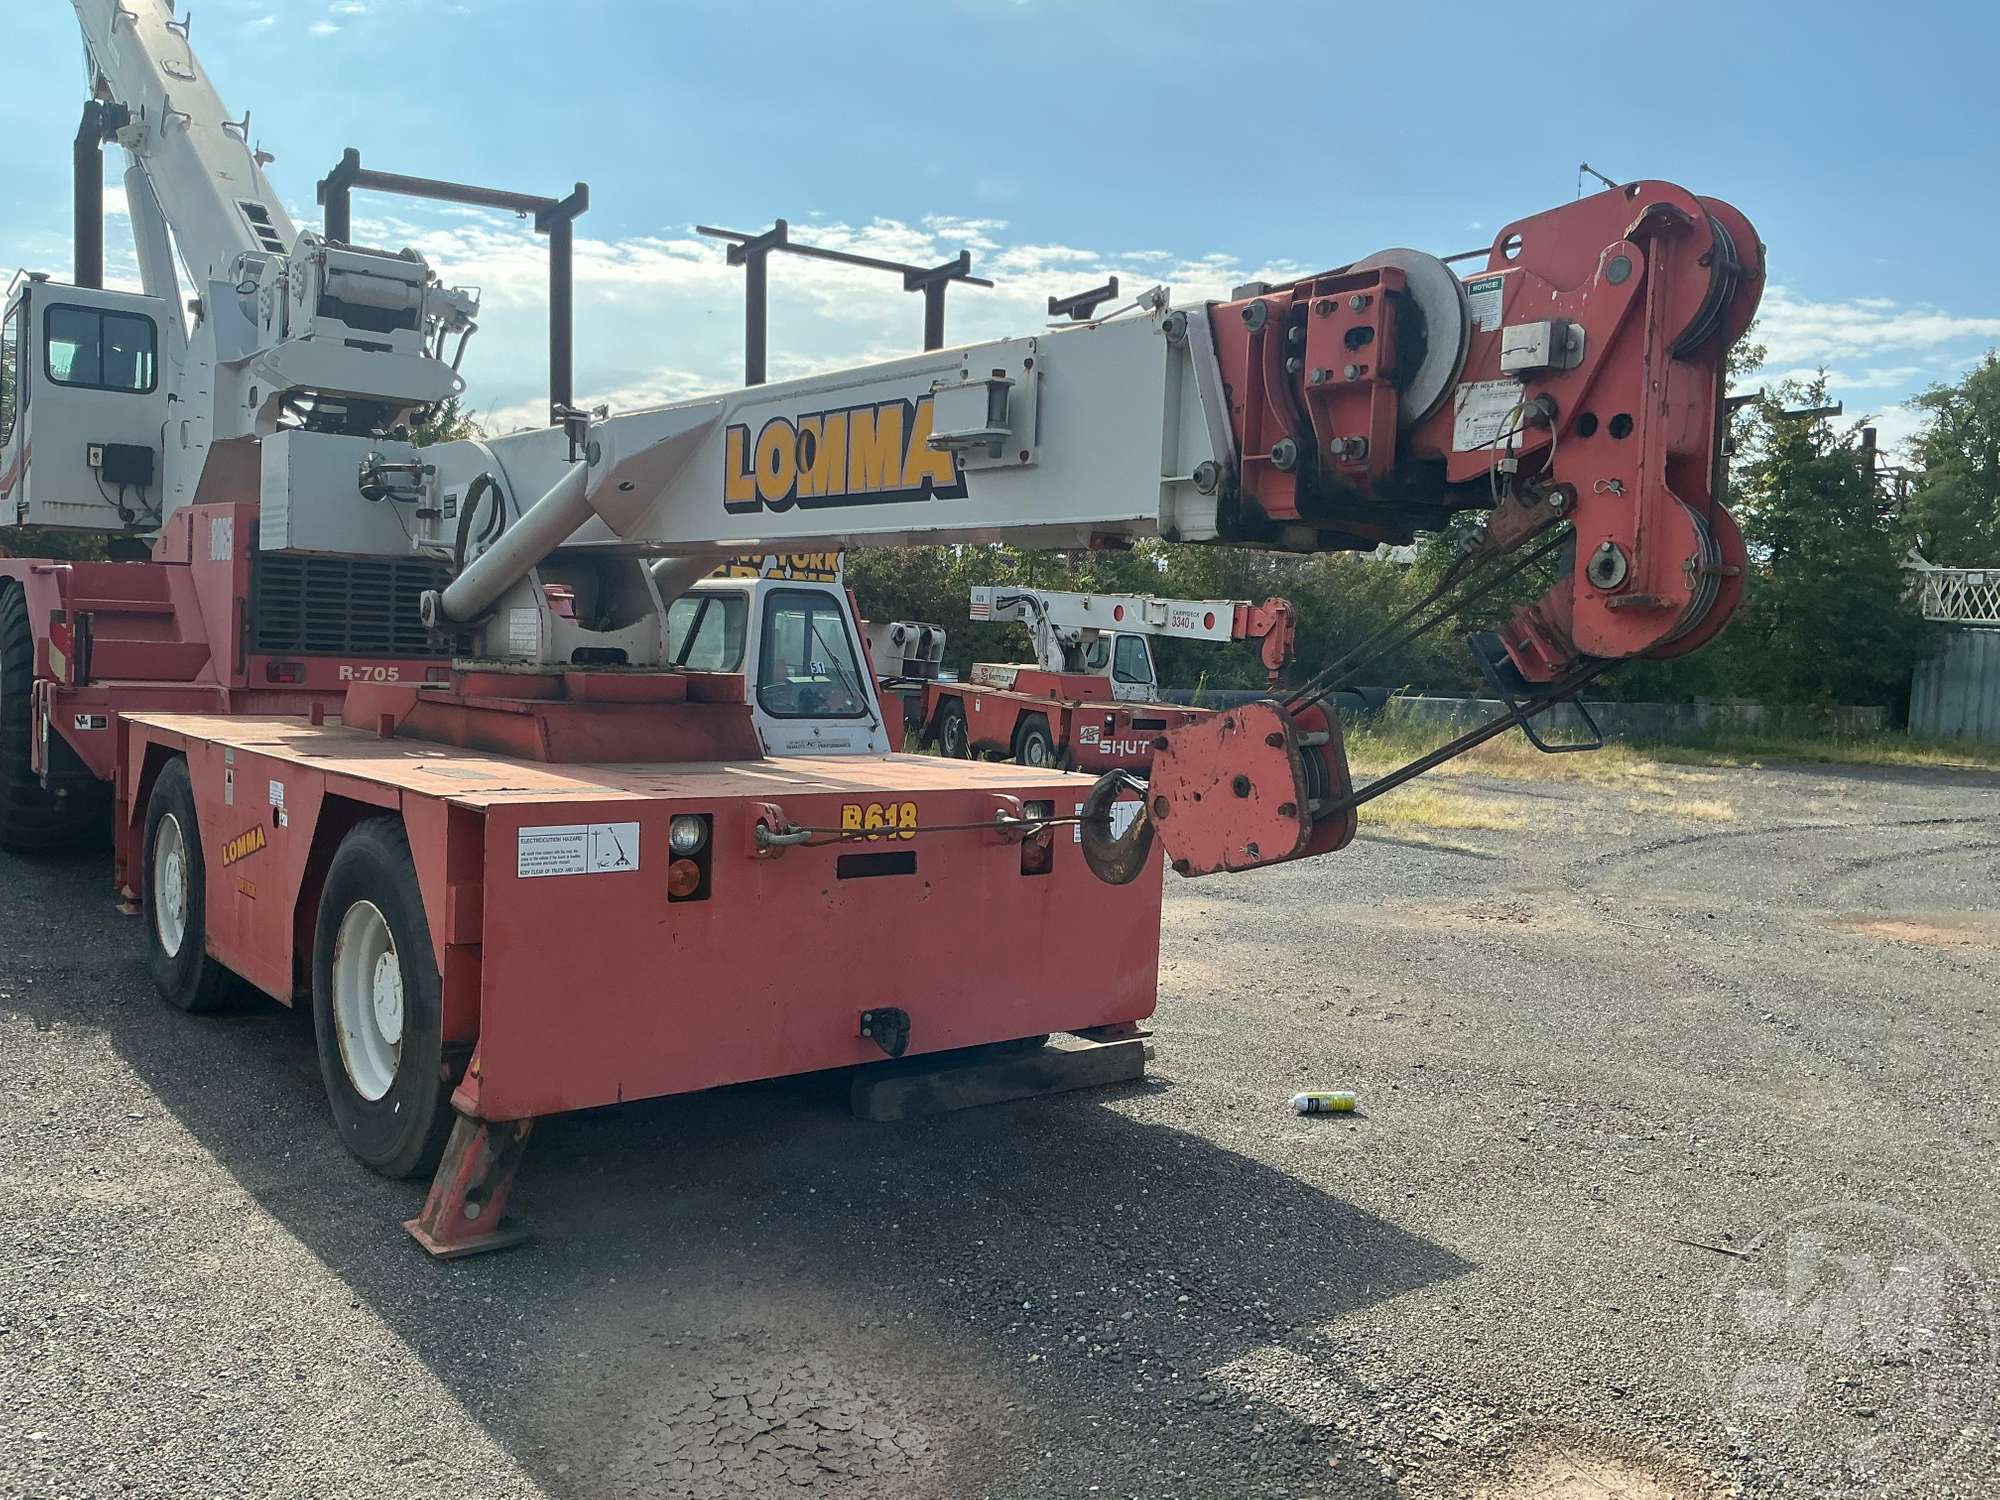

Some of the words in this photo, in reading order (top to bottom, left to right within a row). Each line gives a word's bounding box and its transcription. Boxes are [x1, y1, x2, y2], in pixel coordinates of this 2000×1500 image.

[724, 394, 968, 514] LOMMA
[339, 665, 400, 682] R-705
[811, 662, 824, 673] 51
[222, 824, 267, 867] LOMMA
